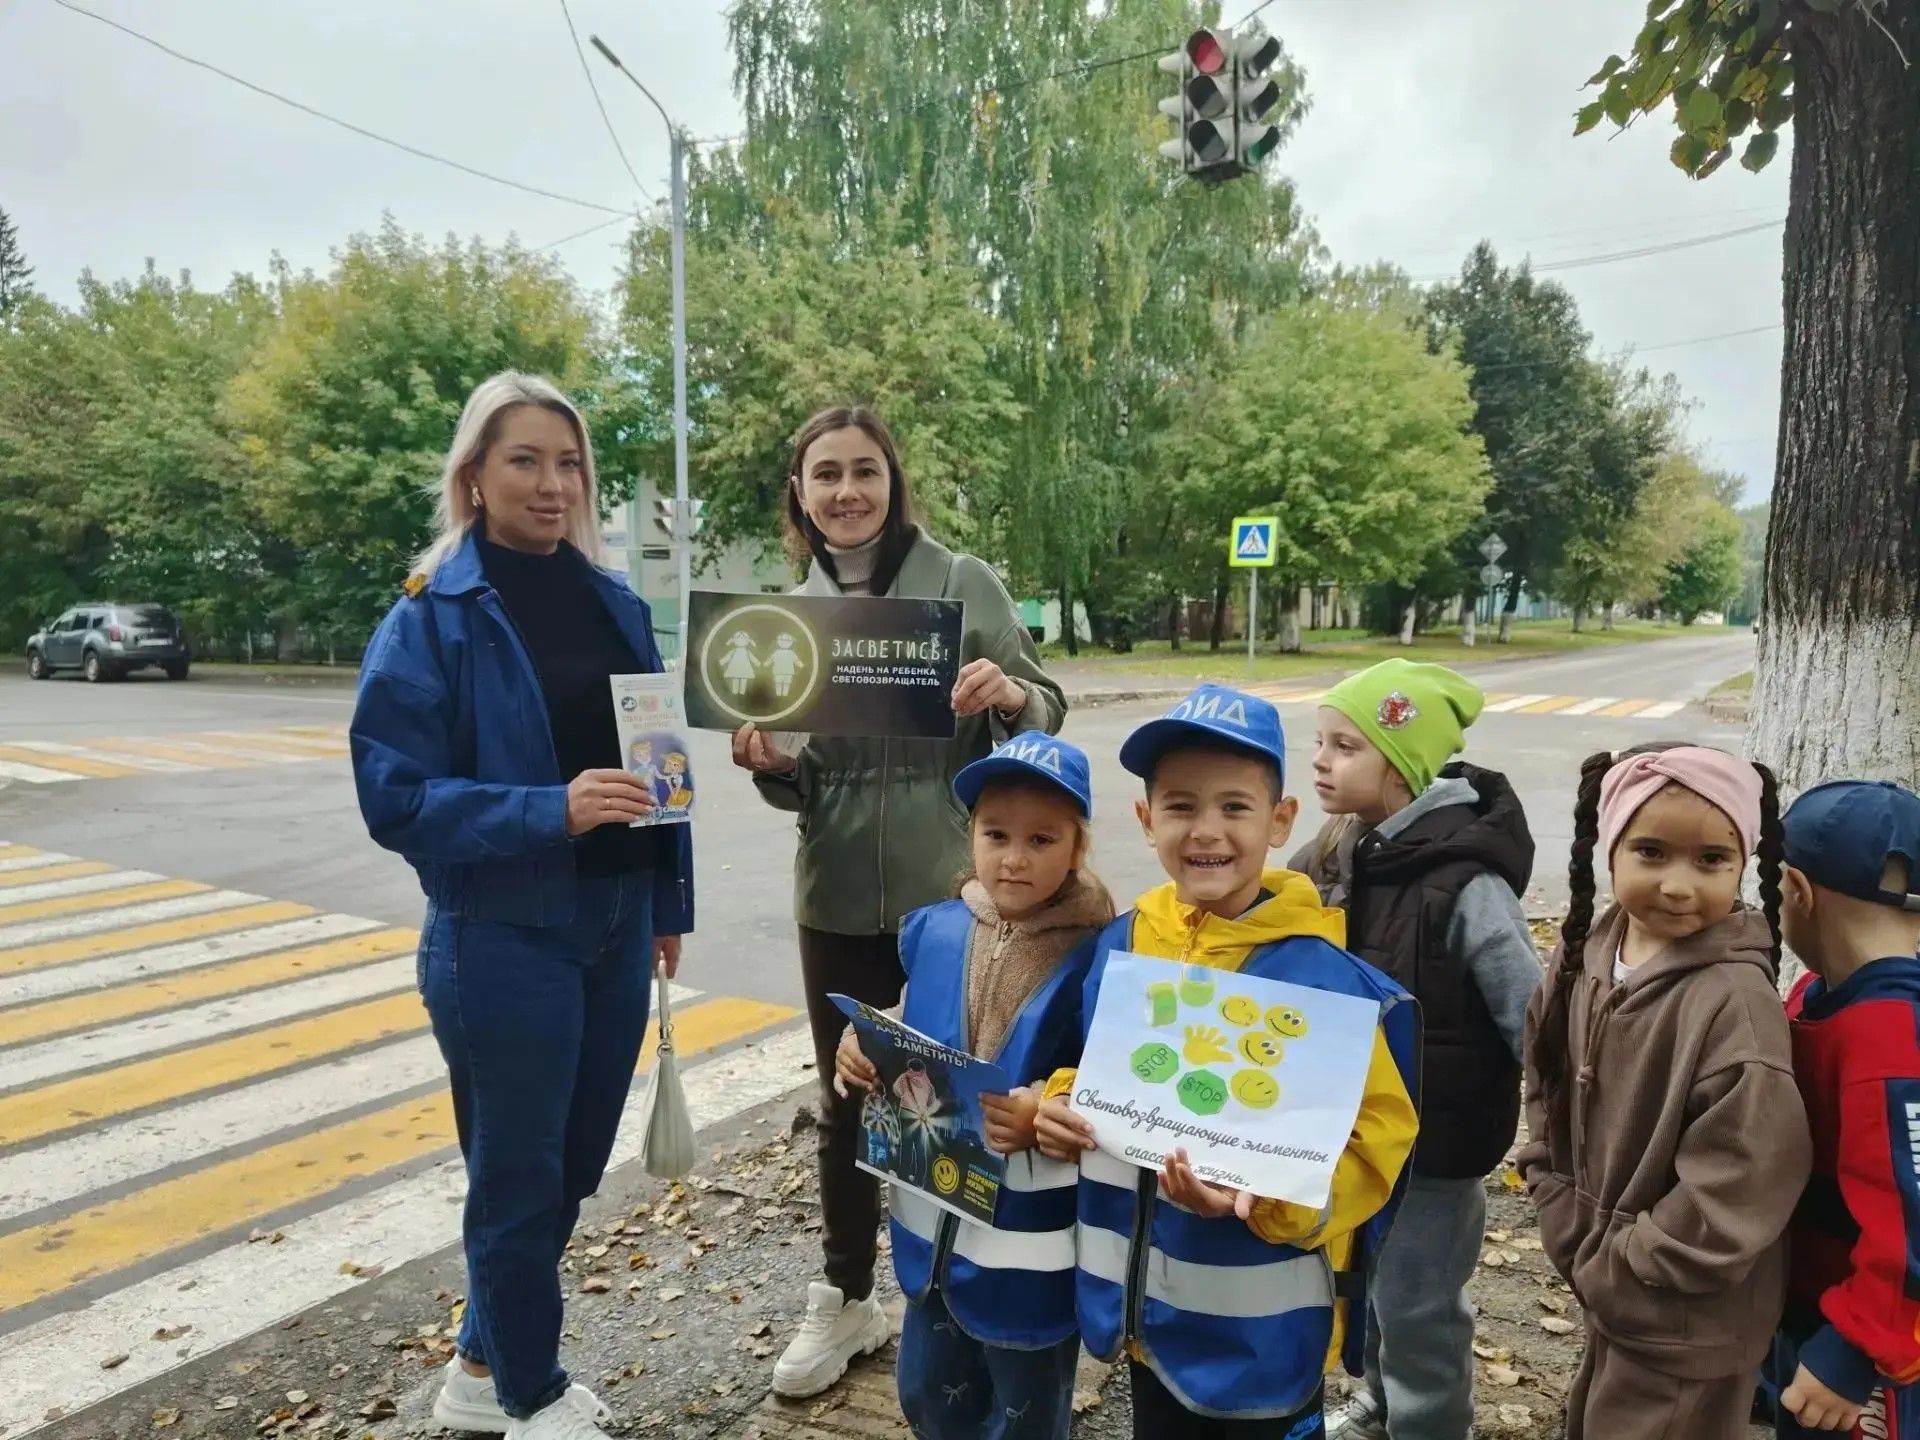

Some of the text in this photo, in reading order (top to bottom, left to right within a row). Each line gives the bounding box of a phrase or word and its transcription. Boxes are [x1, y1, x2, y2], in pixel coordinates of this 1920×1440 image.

[831, 638, 948, 661] ЗАСВЕТИСЬ!
[832, 675, 940, 686] СВЕТОВОЗВРАЩАТЕЛЬ
[837, 665, 936, 676] НАДЕНЬ НА РЕБЕНКА
[894, 1037, 968, 1069] ЗАМЕТИТЬ!
[1136, 1047, 1169, 1078] STOP
[1183, 1076, 1223, 1105] STOP
[1076, 1088, 1329, 1163] Световозвращающие элементы
[1124, 1145, 1251, 1187] спаса жизнь.
